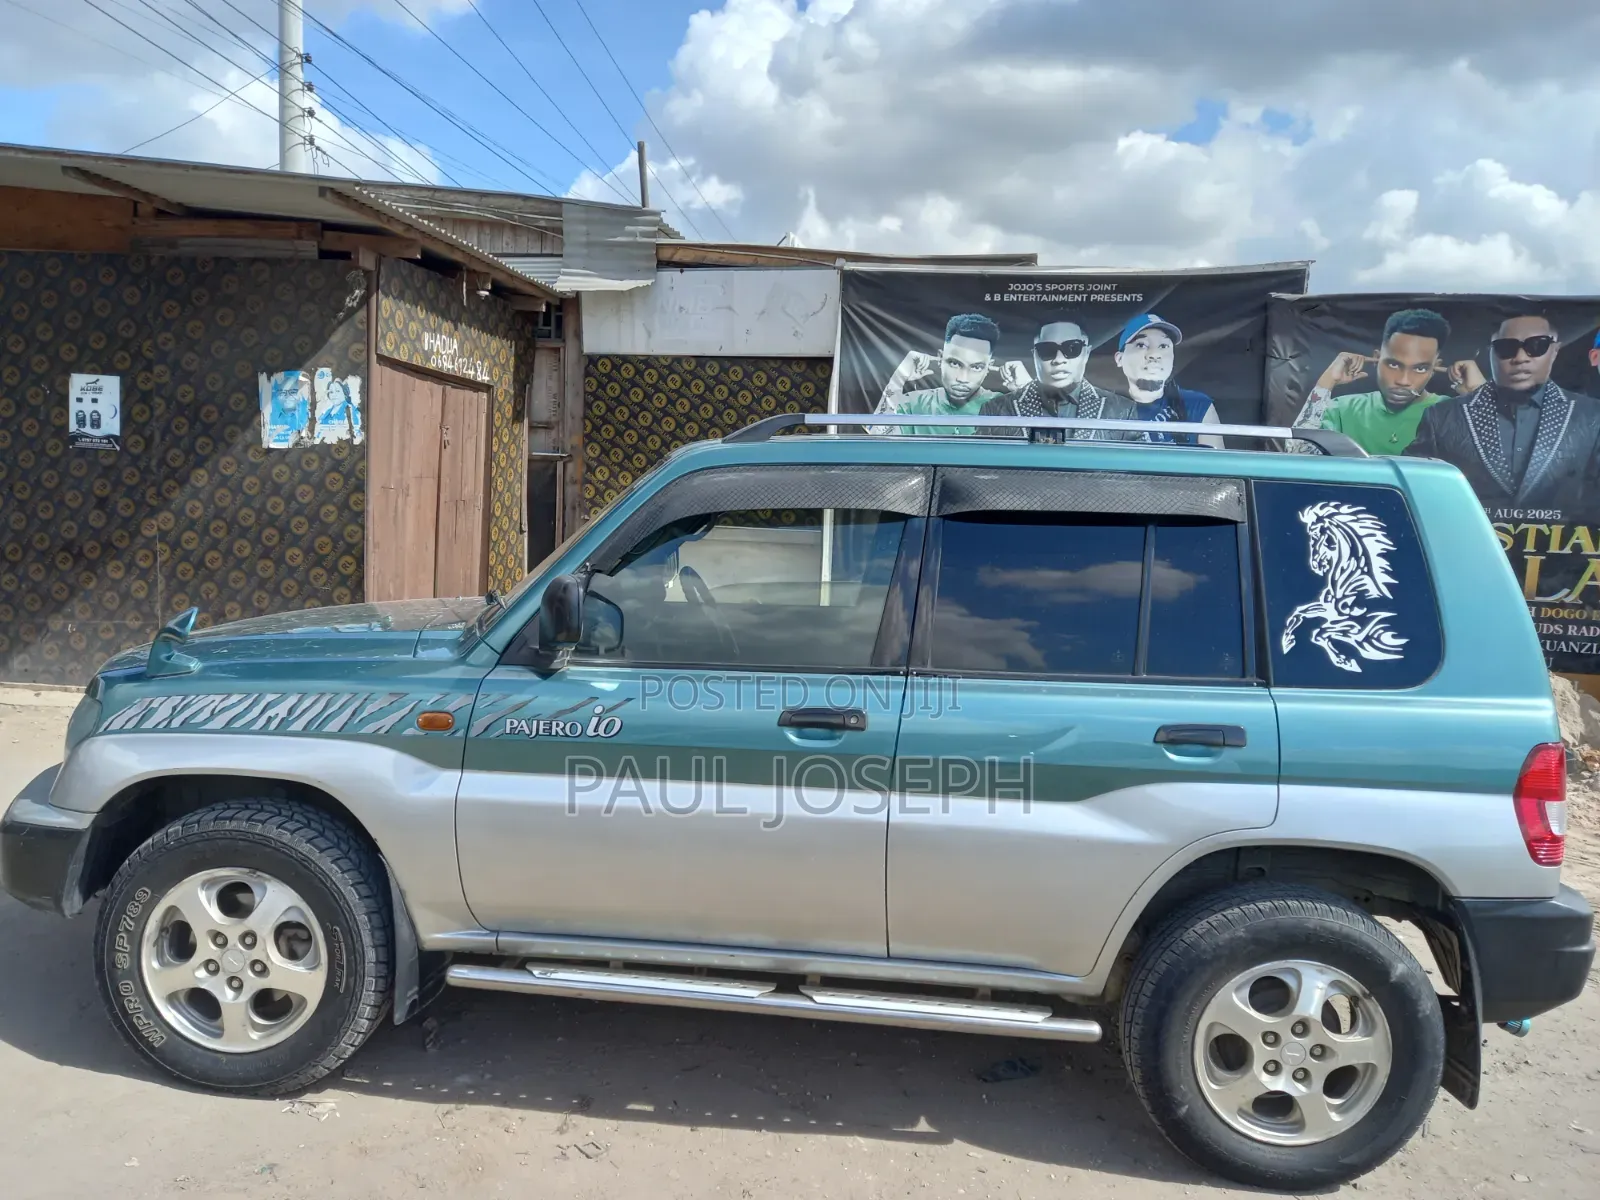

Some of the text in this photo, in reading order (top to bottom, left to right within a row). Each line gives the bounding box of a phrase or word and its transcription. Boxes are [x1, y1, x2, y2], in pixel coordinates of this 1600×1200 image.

[1008, 283, 1118, 291] JOJO'S SPORTS JOINT
[1004, 294, 1088, 302] ENTERTAINMENT
[1090, 294, 1143, 302] PRESENTS
[1494, 508, 1524, 518] AUG
[1527, 509, 1562, 519] 2025
[1492, 522, 1600, 555] STIA
[1541, 607, 1587, 620] DOGO
[505, 705, 623, 738] PAJERO io
[115, 886, 151, 969] SP789
